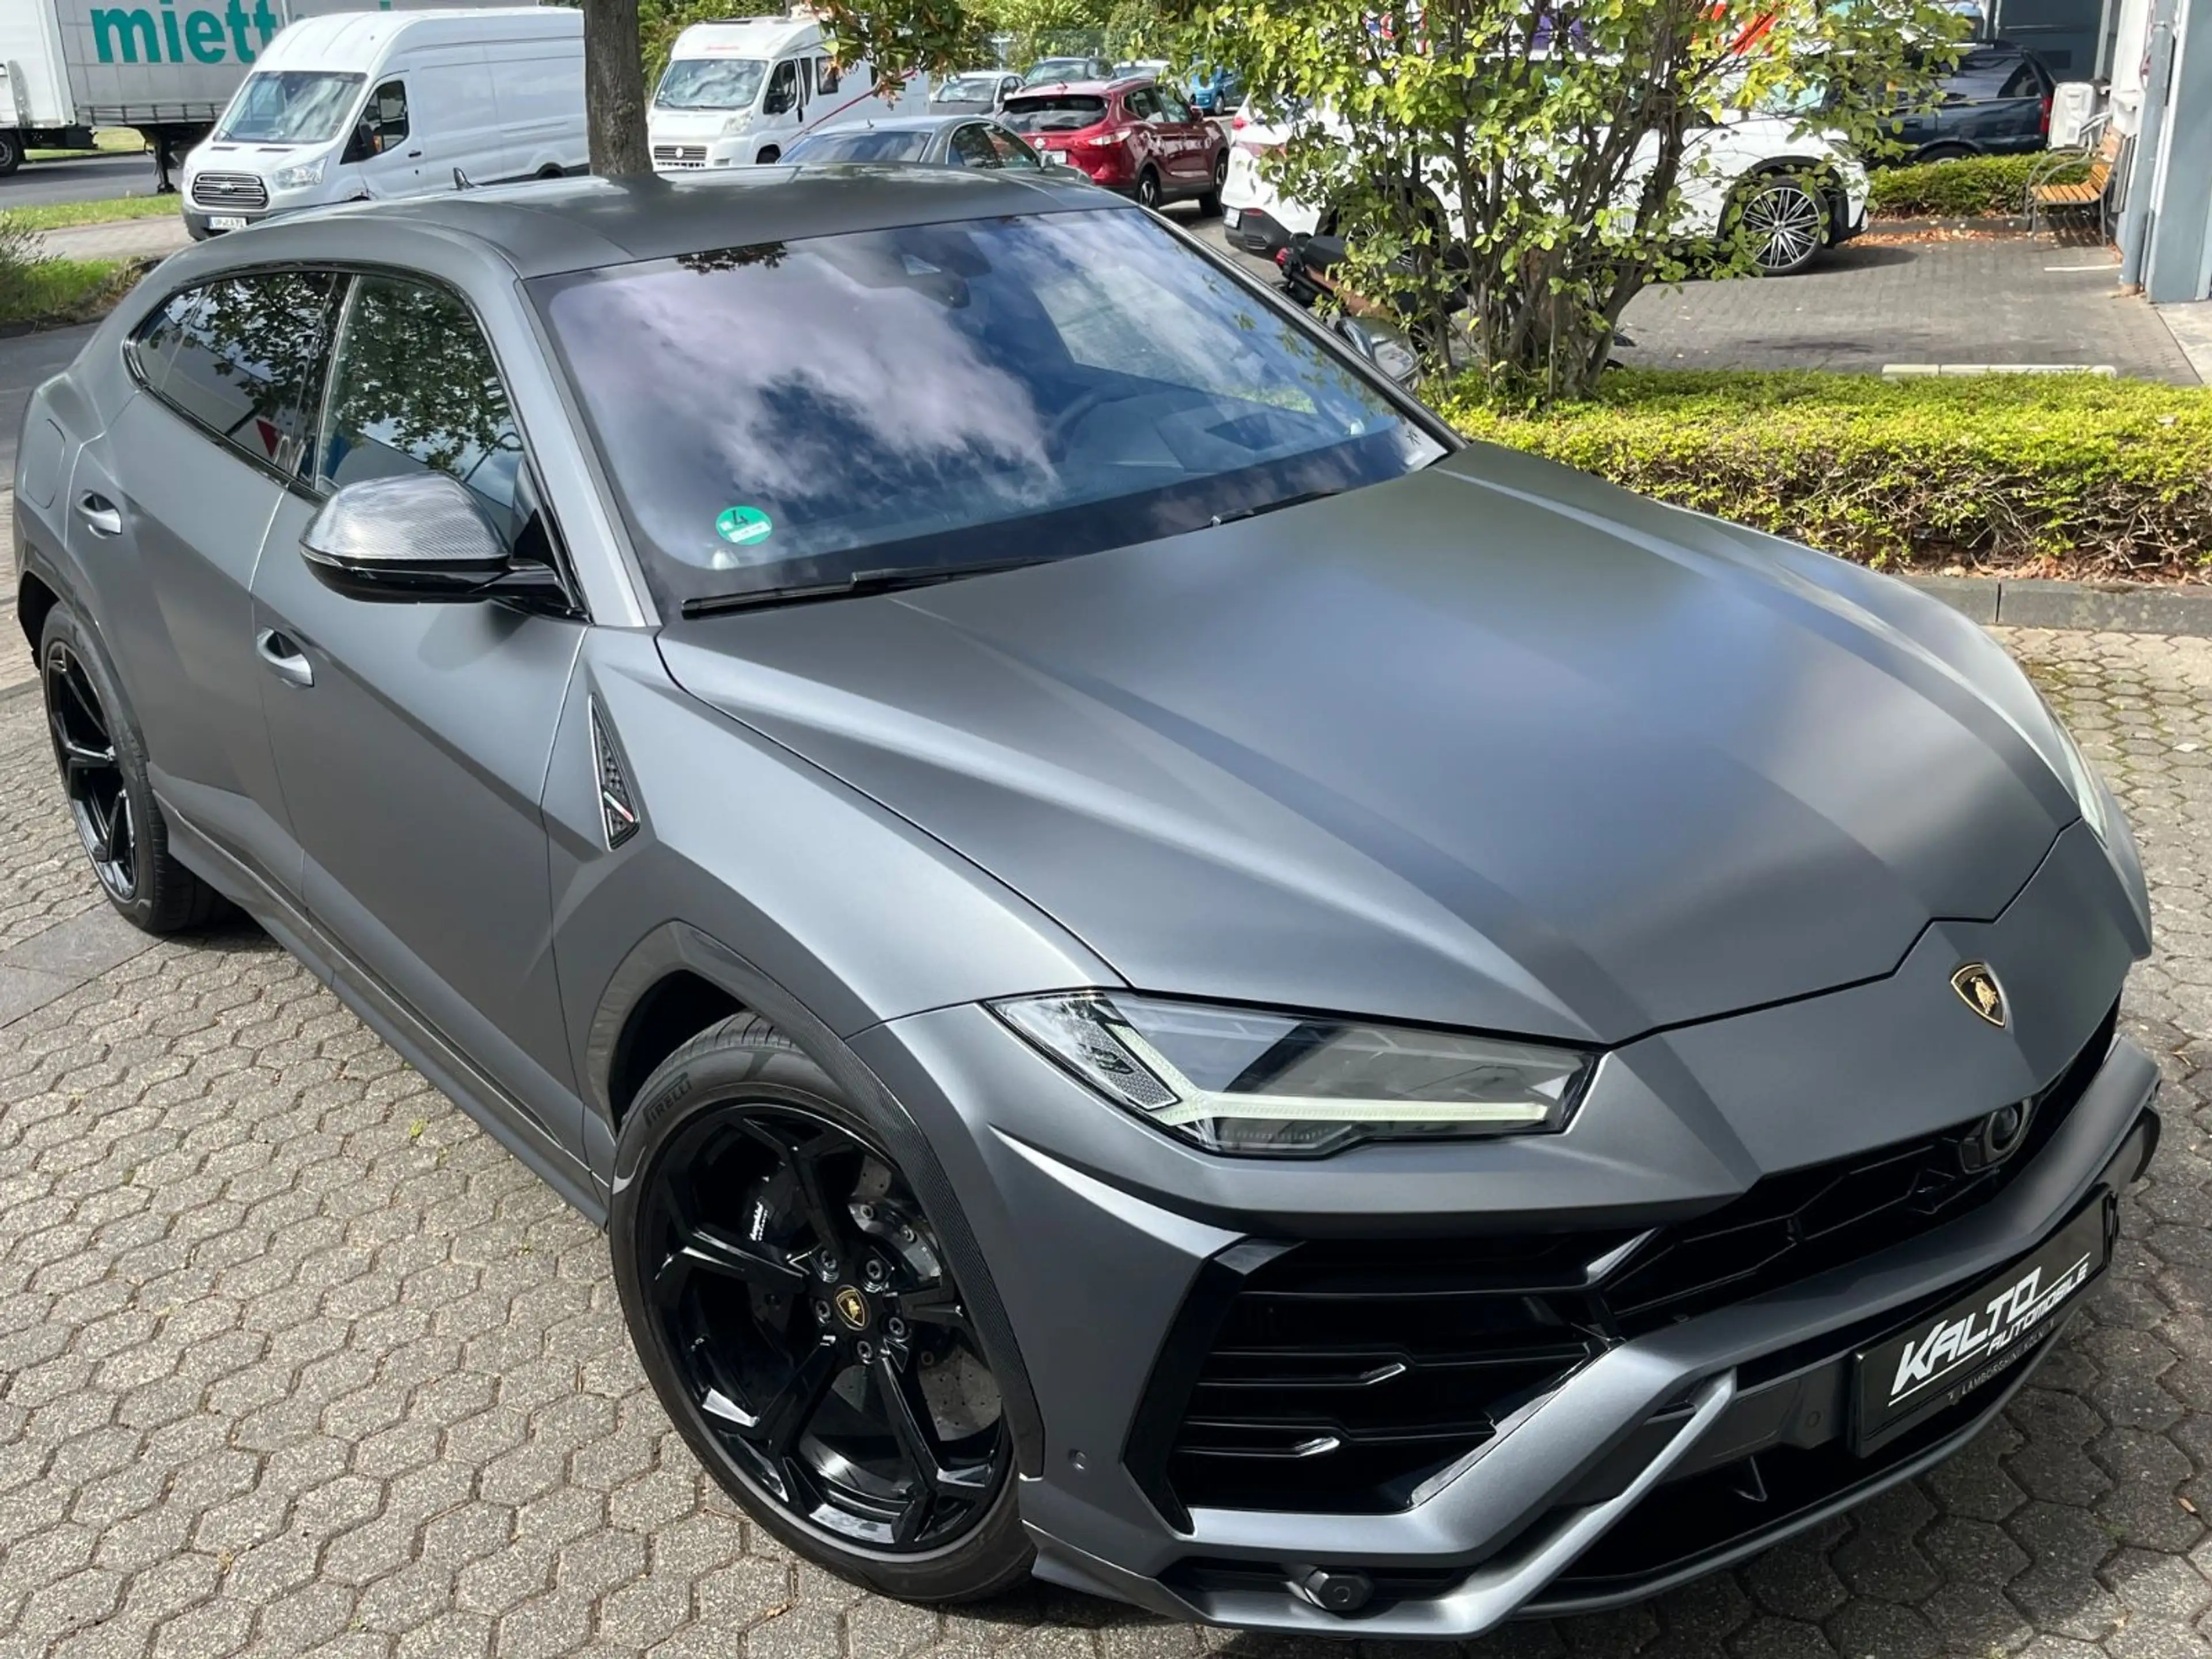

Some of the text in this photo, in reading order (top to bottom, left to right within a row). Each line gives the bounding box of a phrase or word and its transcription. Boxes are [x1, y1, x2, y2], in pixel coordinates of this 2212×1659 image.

[90, 0, 278, 63] miett
[643, 1071, 692, 1128] PIRELLI
[1892, 1267, 2041, 1395] KALTO
[1987, 1263, 2088, 1356] AUTOMOBILE
